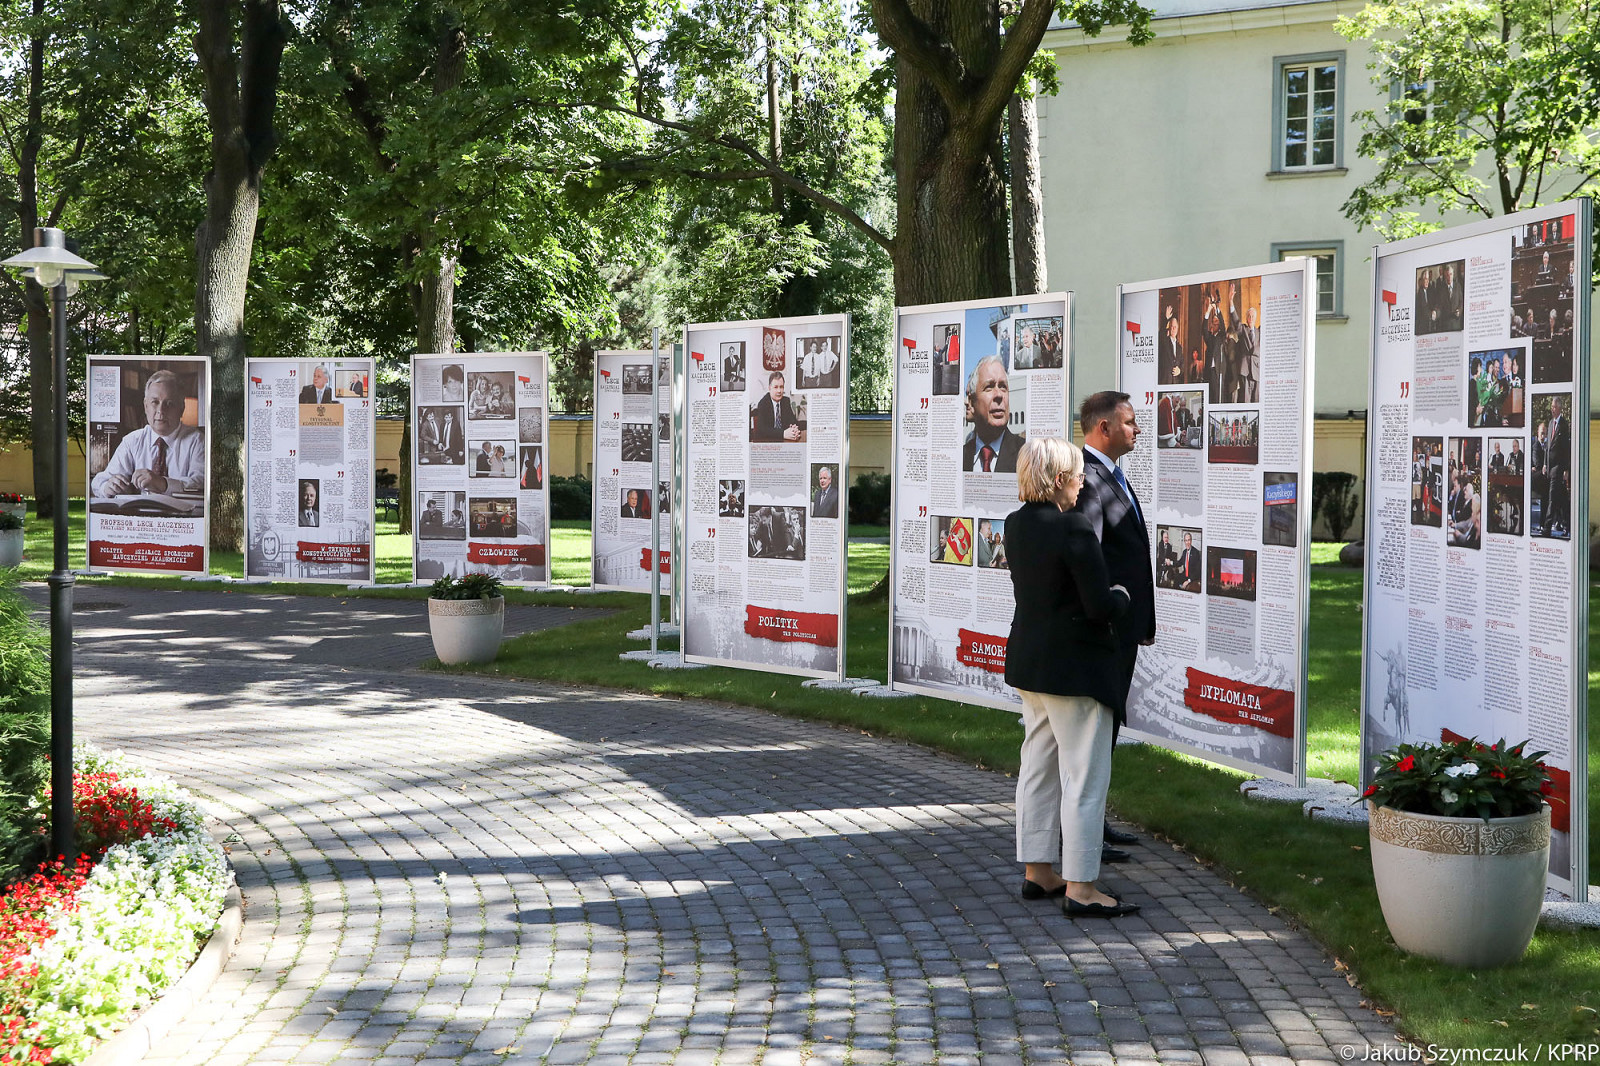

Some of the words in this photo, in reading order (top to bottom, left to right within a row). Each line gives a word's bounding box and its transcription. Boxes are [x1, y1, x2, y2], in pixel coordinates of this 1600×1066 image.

[1390, 307, 1410, 322] LECH
[1380, 323, 1410, 336] KACZYŃSKI
[1135, 336, 1153, 347] LECH
[911, 351, 928, 360] LECH
[700, 363, 716, 371] LECH
[158, 521, 194, 529] KACZYŃSKI
[479, 548, 519, 556] CZŁOWIEK
[758, 615, 799, 629] POLITYK
[989, 658, 1005, 666] GOVERN
[1200, 684, 1262, 710] DYPLOMATA
[1238, 710, 1248, 718] THE
[1250, 712, 1274, 724] DIPLOMAT
